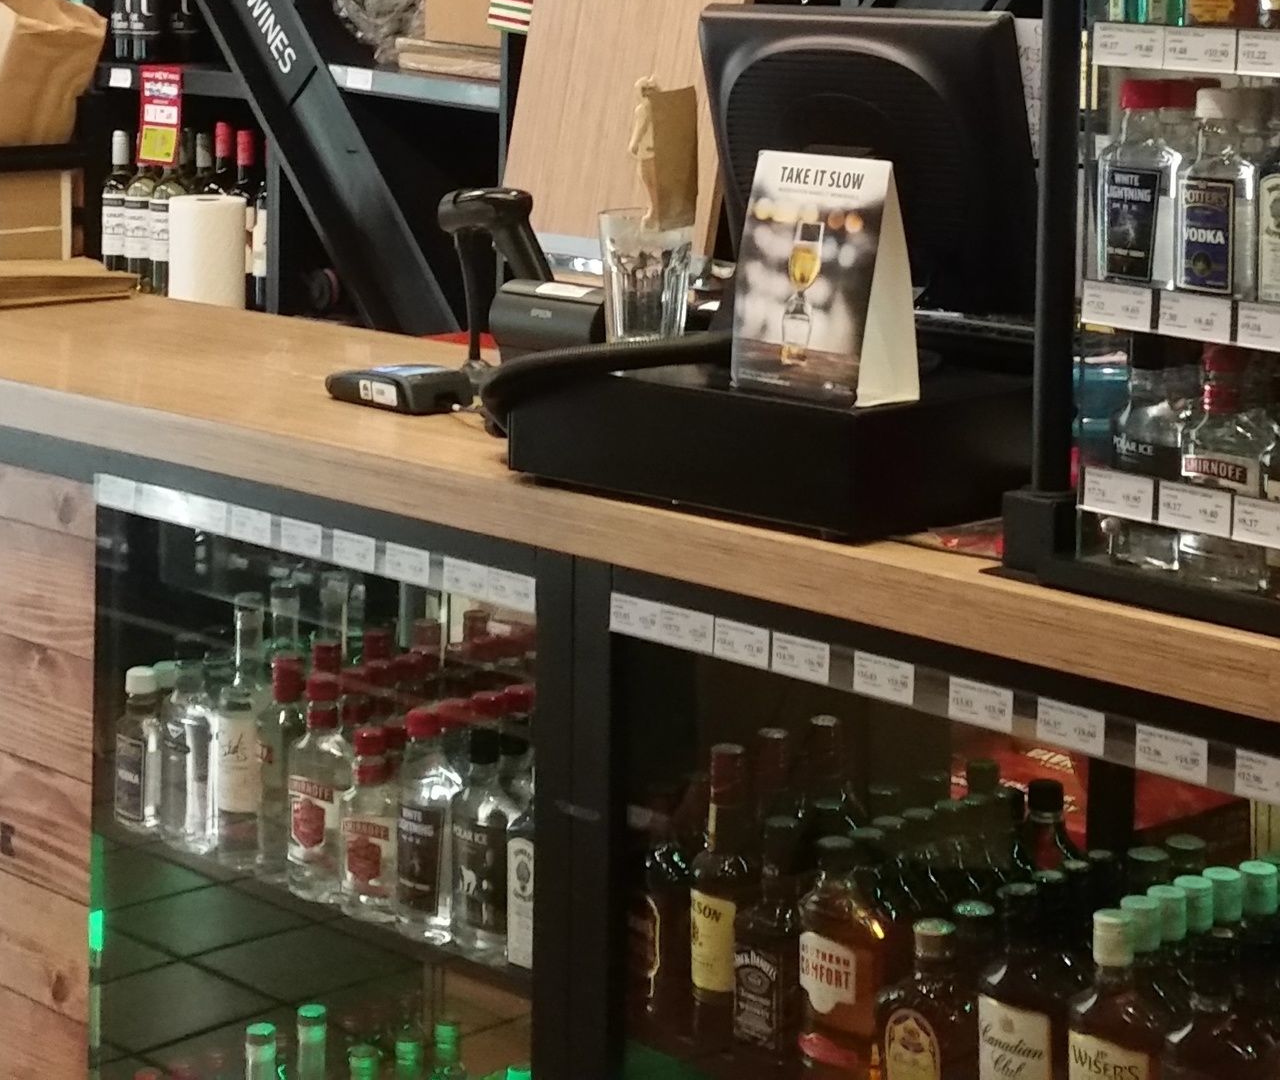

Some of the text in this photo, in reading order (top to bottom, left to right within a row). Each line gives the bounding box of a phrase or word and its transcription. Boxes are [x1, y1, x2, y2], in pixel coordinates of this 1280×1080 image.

[778, 165, 865, 191] TAKE IT SLOW
[1183, 225, 1226, 245] VODKA
[1137, 444, 1153, 456] ICE
[1184, 456, 1245, 482] SMIRNOFF
[799, 956, 852, 991] COMFORT
[980, 1024, 1045, 1062] Canadian
[1071, 1043, 1141, 1080] WISER'S
